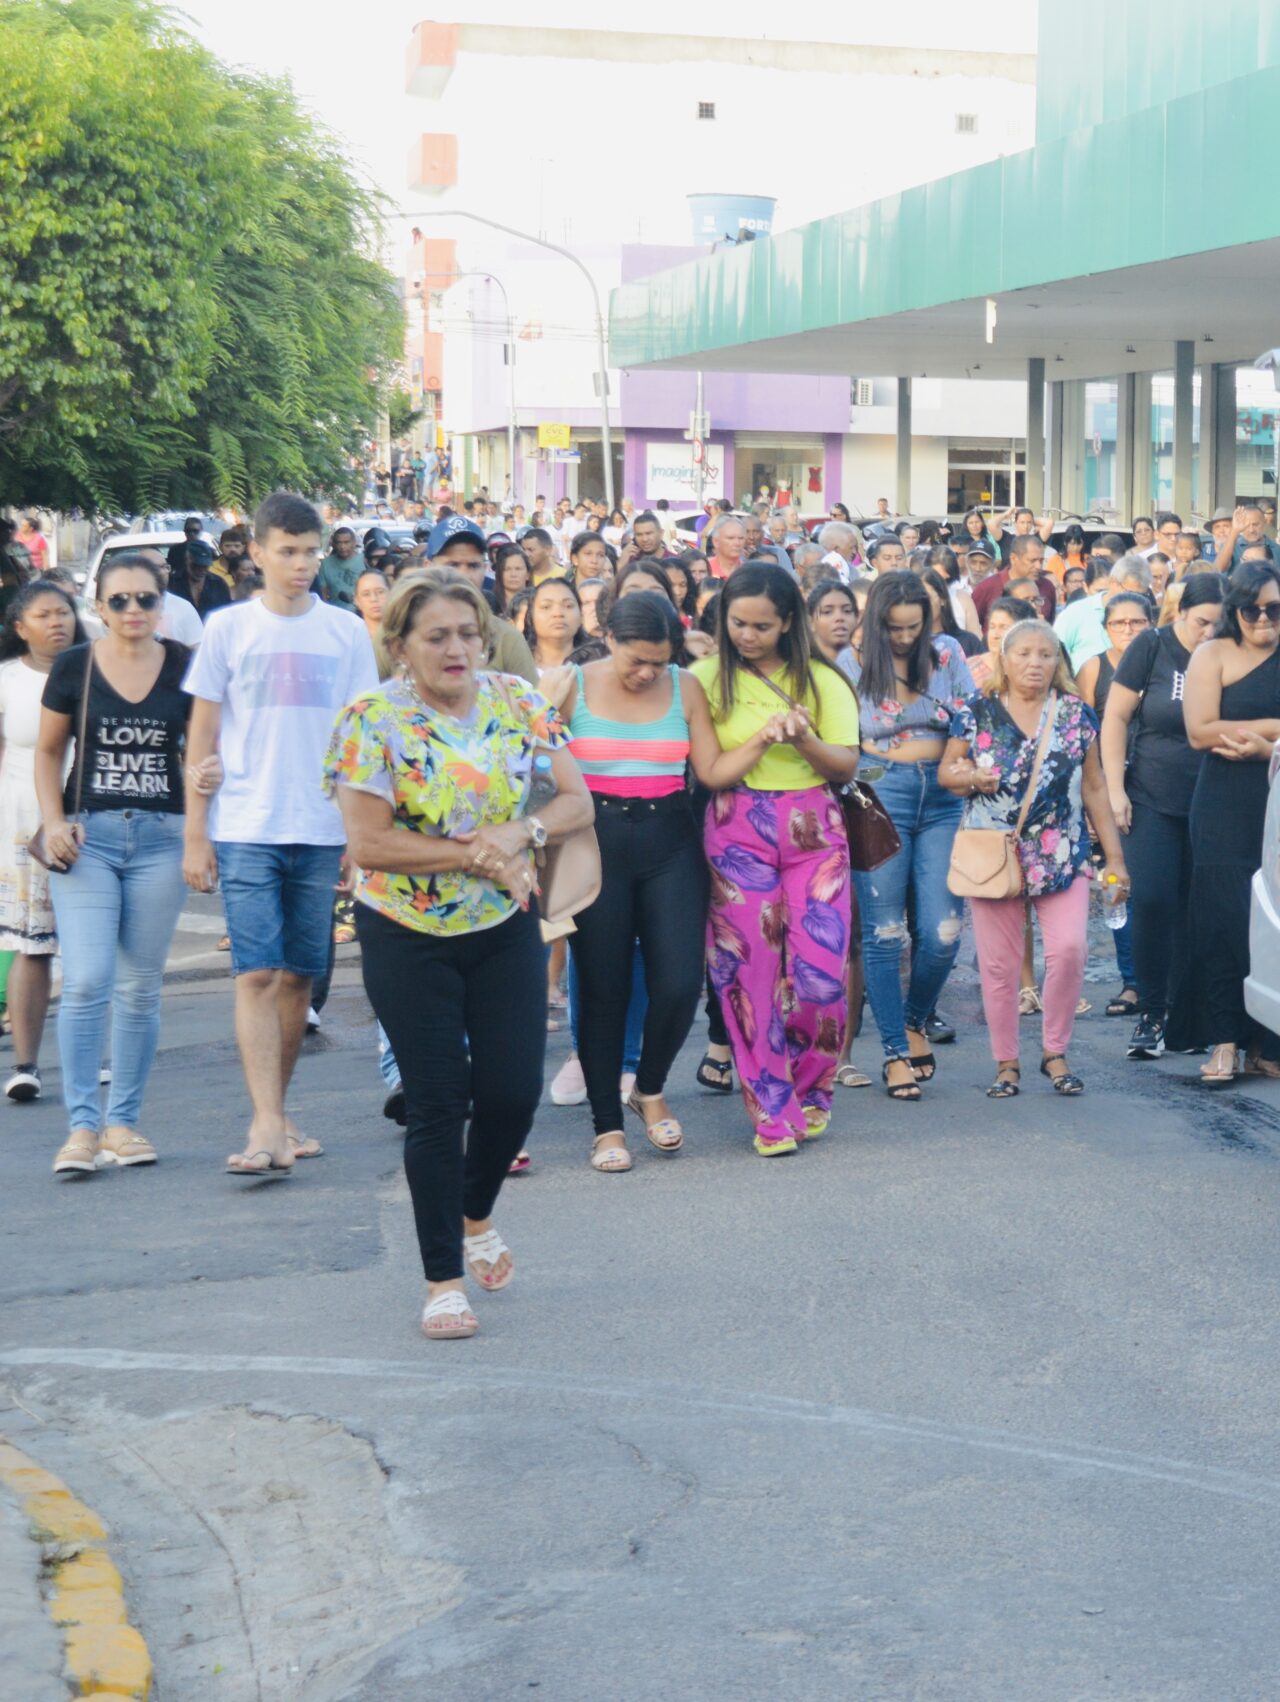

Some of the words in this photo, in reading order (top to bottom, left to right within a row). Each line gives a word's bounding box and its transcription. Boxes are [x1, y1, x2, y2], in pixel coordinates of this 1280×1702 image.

[102, 717, 119, 726] BE
[124, 717, 167, 727] HAPPY
[101, 727, 167, 747] LOVE
[108, 752, 158, 773] LIVE
[92, 772, 171, 793] LEARN
